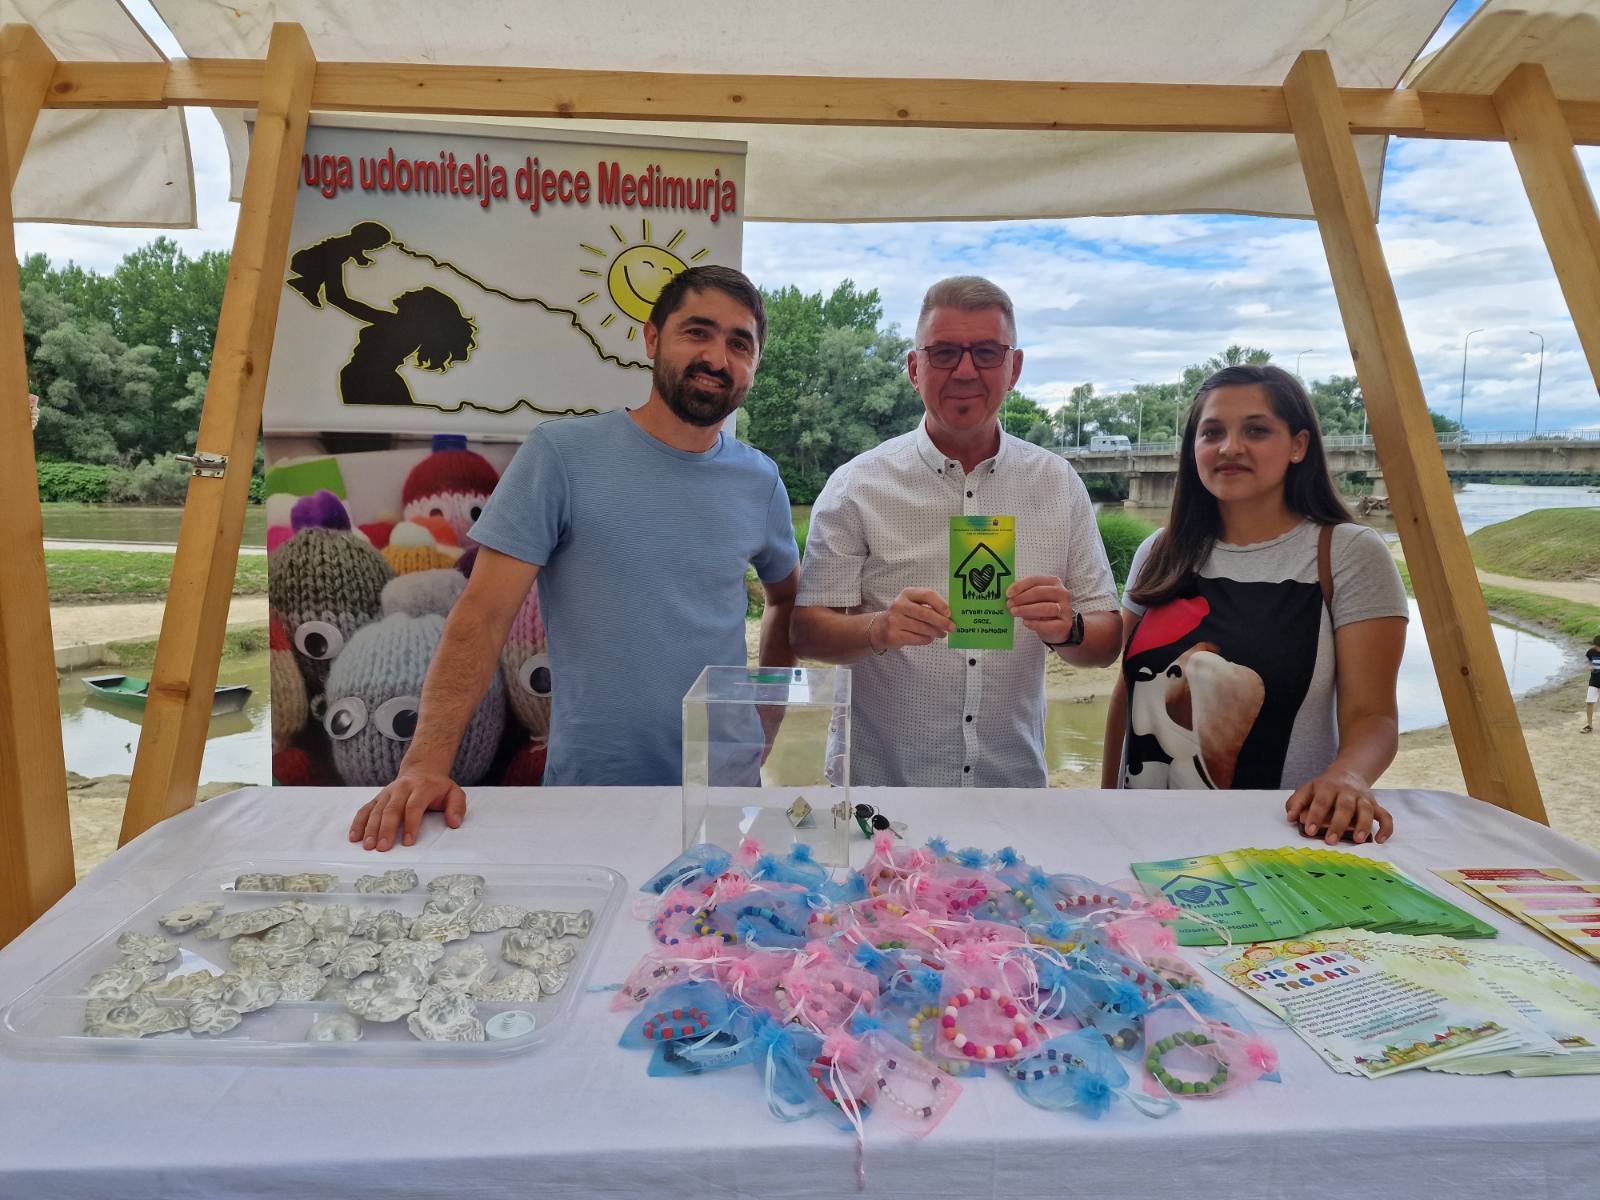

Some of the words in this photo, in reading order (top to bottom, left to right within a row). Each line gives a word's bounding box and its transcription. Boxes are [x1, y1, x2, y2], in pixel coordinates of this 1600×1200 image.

[301, 153, 353, 199] uga
[359, 147, 508, 208] udomitelja
[515, 156, 591, 213] djece
[598, 161, 737, 223] Međimurja
[1252, 962, 1311, 982] DJECA
[1274, 964, 1361, 992] TREBAJU
